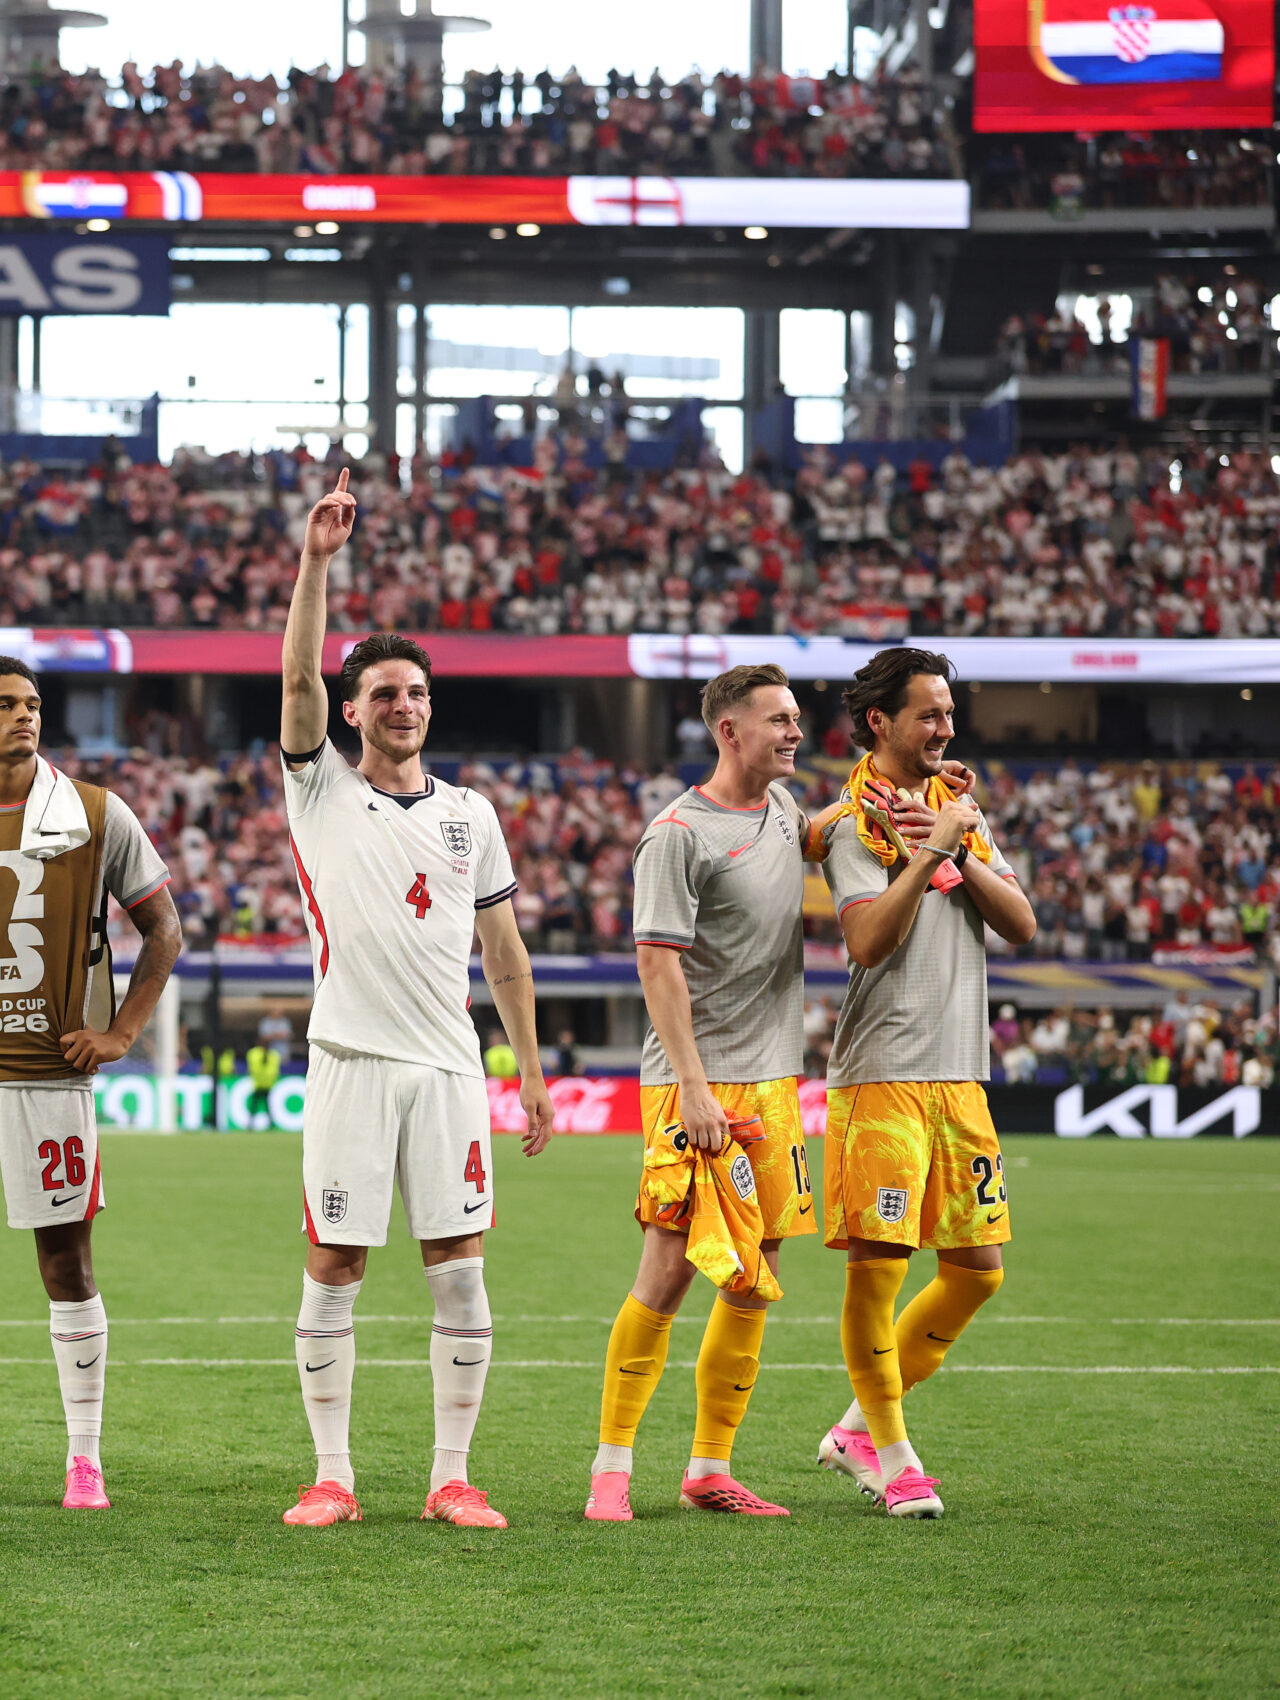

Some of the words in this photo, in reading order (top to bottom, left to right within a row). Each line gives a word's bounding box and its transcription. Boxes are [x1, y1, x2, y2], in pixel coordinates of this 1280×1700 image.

[405, 872, 433, 920] 4
[16, 997, 46, 1012] CUP
[37, 1135, 87, 1192] 26
[463, 1140, 486, 1194] 4
[791, 1143, 812, 1196] 13
[970, 1152, 1007, 1206] 23
